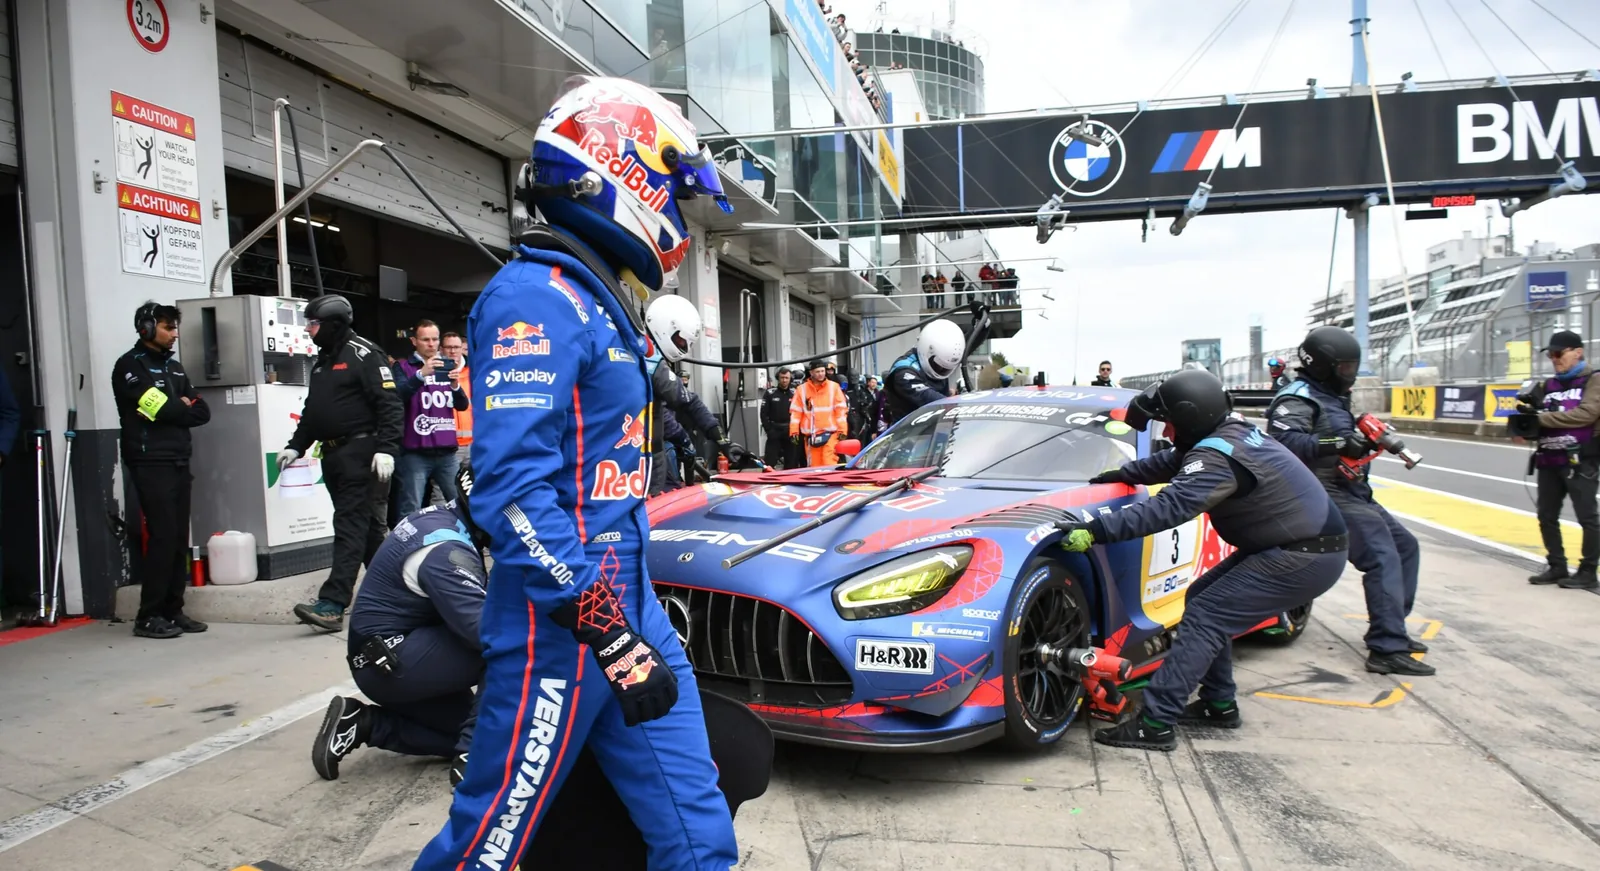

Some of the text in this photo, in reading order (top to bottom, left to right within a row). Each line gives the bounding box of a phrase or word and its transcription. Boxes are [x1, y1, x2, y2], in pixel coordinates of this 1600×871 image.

[132, 104, 178, 129] CAUTION
[1457, 97, 1600, 164] BM
[164, 140, 188, 154] WATCH
[158, 149, 195, 167] YOUR HEAD
[133, 192, 189, 217] ACHTUNG
[169, 238, 197, 251] GEFAHR
[268, 338, 275, 350] 9
[503, 368, 557, 385] viaplay
[997, 389, 1096, 401] viaplay
[944, 404, 1060, 418] GRAN TURISMO
[1004, 413, 1048, 421] SIMULATOR
[592, 456, 646, 500] Red
[592, 531, 622, 543] sparco
[680, 530, 827, 563] AMG
[1171, 528, 1180, 565] 3
[962, 608, 1001, 620] sparco
[936, 627, 985, 638] MICHELIN
[860, 645, 900, 666] H&R
